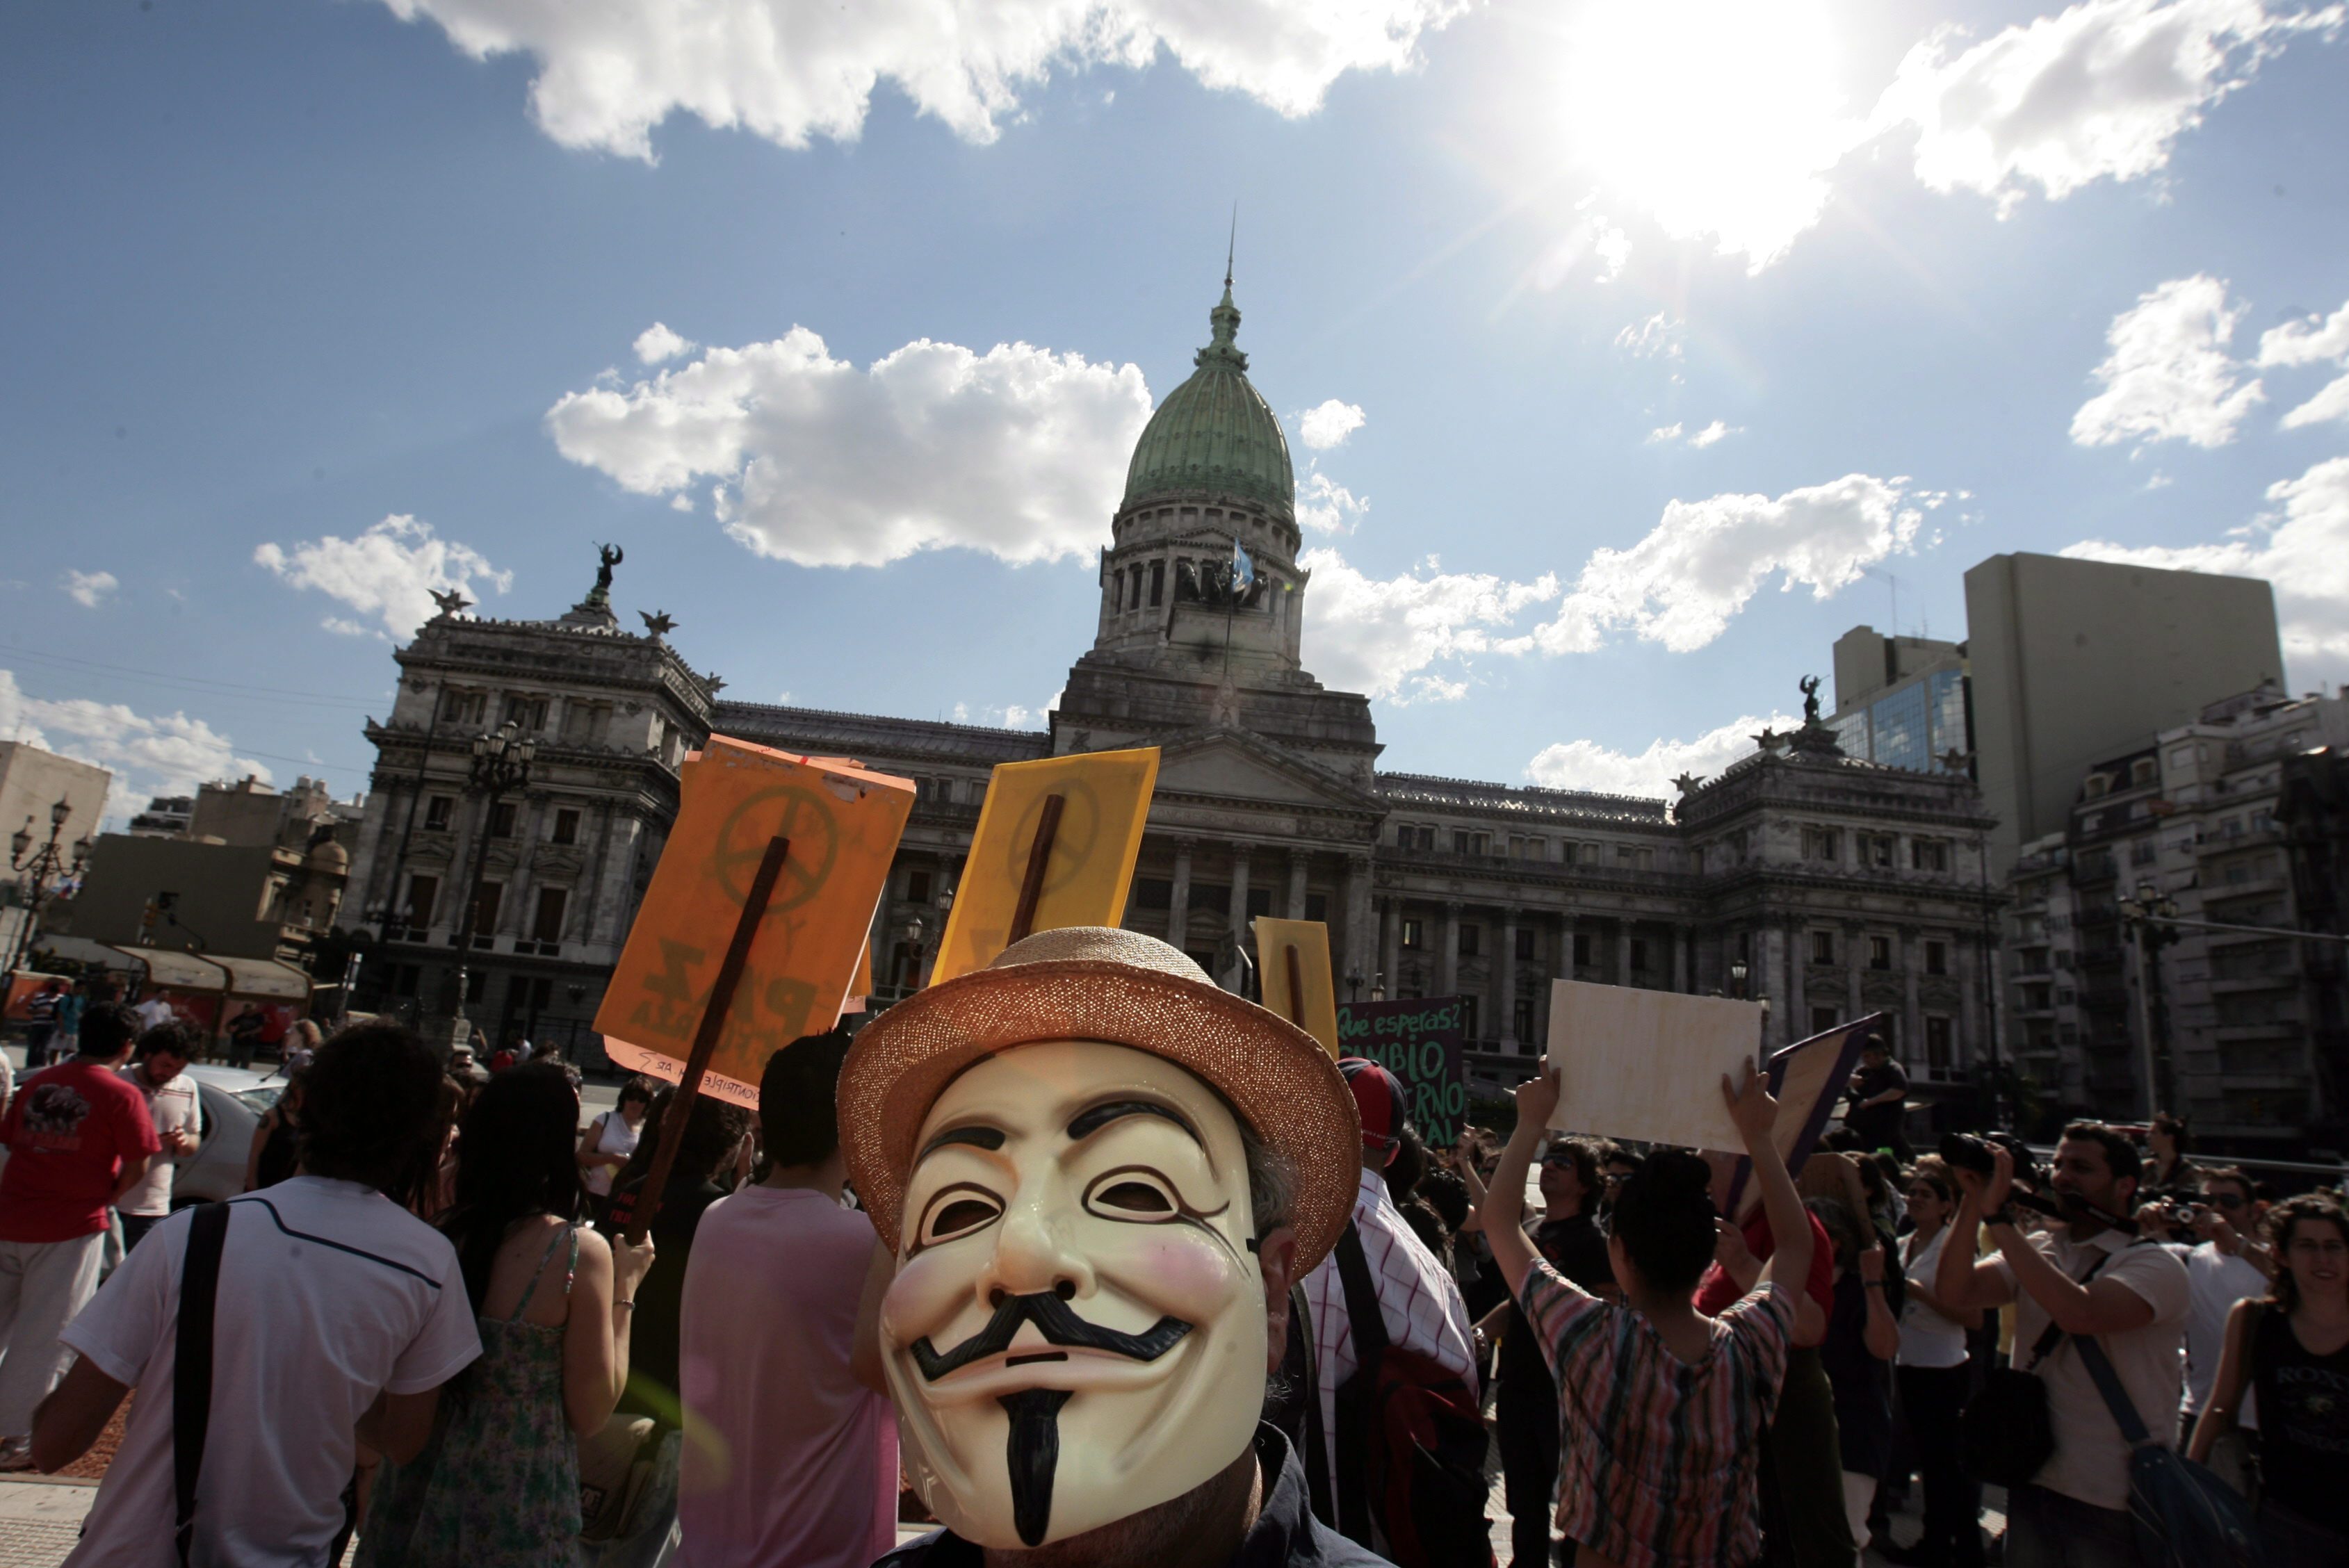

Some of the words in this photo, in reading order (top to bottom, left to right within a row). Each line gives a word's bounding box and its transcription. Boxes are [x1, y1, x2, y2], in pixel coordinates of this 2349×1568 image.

[1155, 808, 1217, 824] ONGRESO
[1374, 1004, 1461, 1038] esperas?
[1406, 1068, 1464, 1124] RNO
